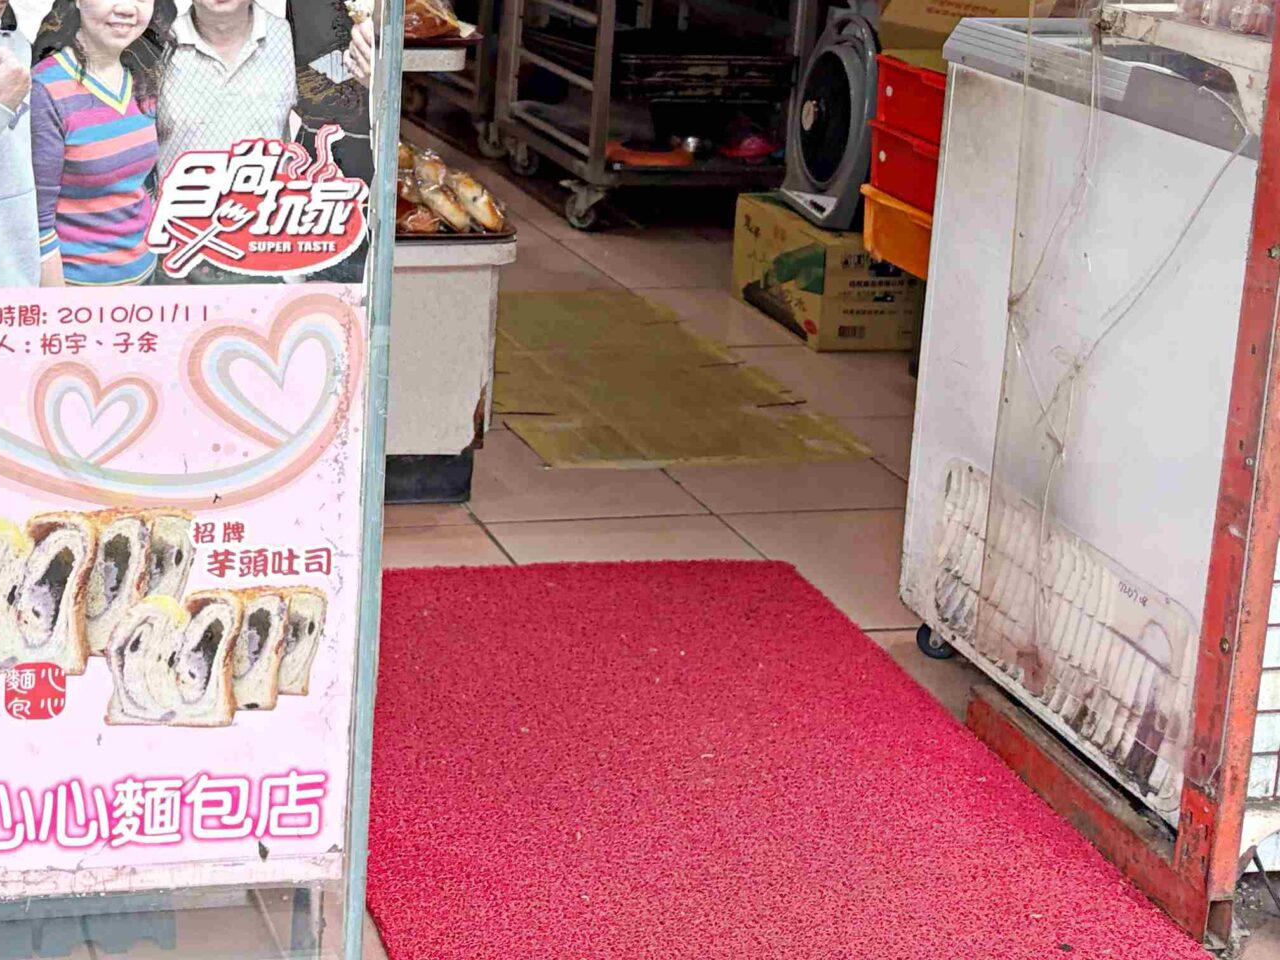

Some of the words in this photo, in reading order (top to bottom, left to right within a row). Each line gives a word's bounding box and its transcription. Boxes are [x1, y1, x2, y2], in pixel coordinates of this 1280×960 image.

[150, 140, 352, 270] 食尚玩家
[248, 241, 291, 253] SUPER
[297, 241, 337, 253] TASTE
[58, 303, 208, 325] 2010/01/11
[193, 522, 245, 544] 招牌
[206, 547, 333, 578] 芋頭吐司
